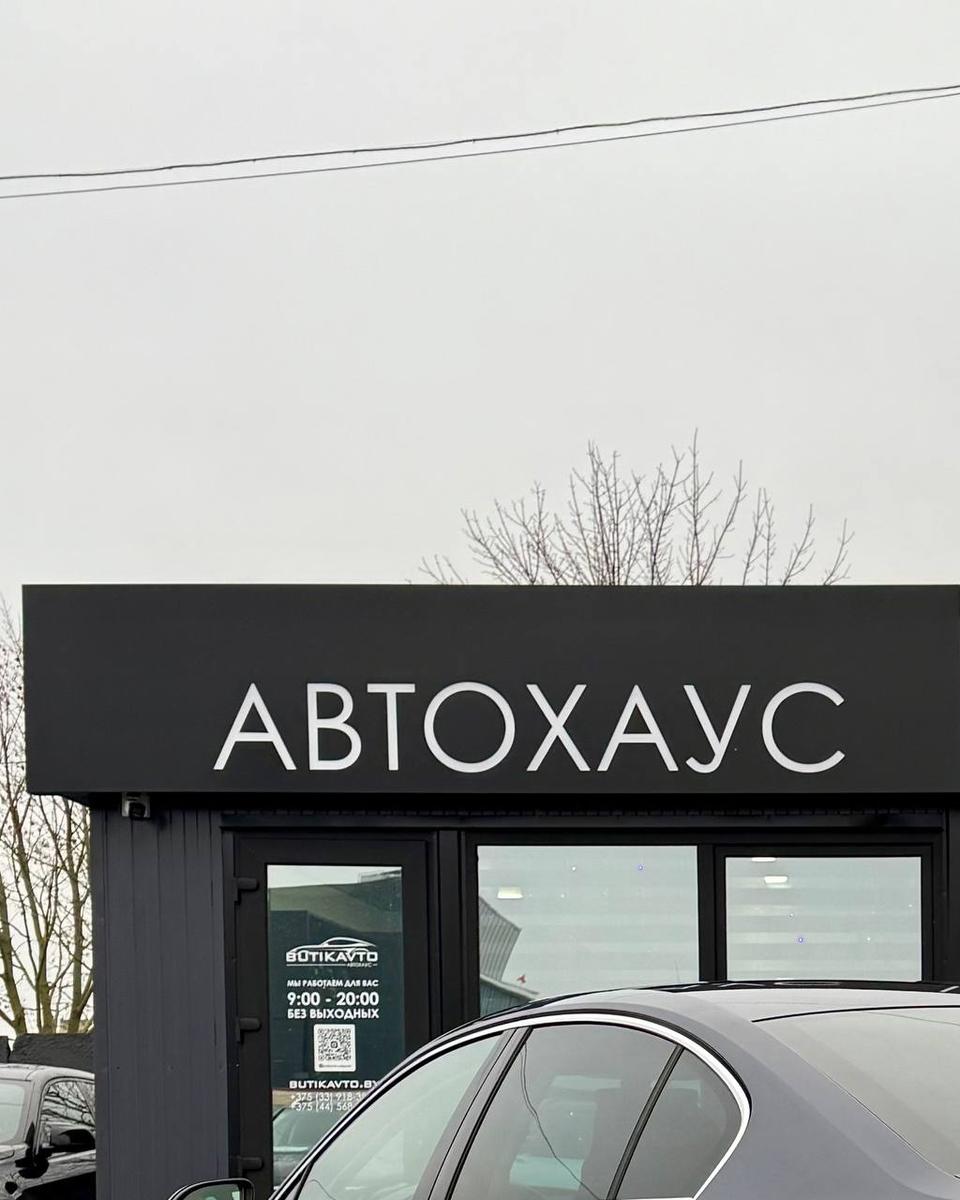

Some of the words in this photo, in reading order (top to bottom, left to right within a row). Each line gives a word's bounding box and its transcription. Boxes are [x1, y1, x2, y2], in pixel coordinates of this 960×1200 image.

[213, 682, 846, 773] АВТОХАУС
[285, 950, 379, 963] BUTIKAVTO
[287, 991, 321, 1006] 9:00
[336, 991, 380, 1006] 20:00
[287, 1008, 307, 1019] БЕЗ
[309, 1008, 379, 1020] ВЫХОДНЫХ
